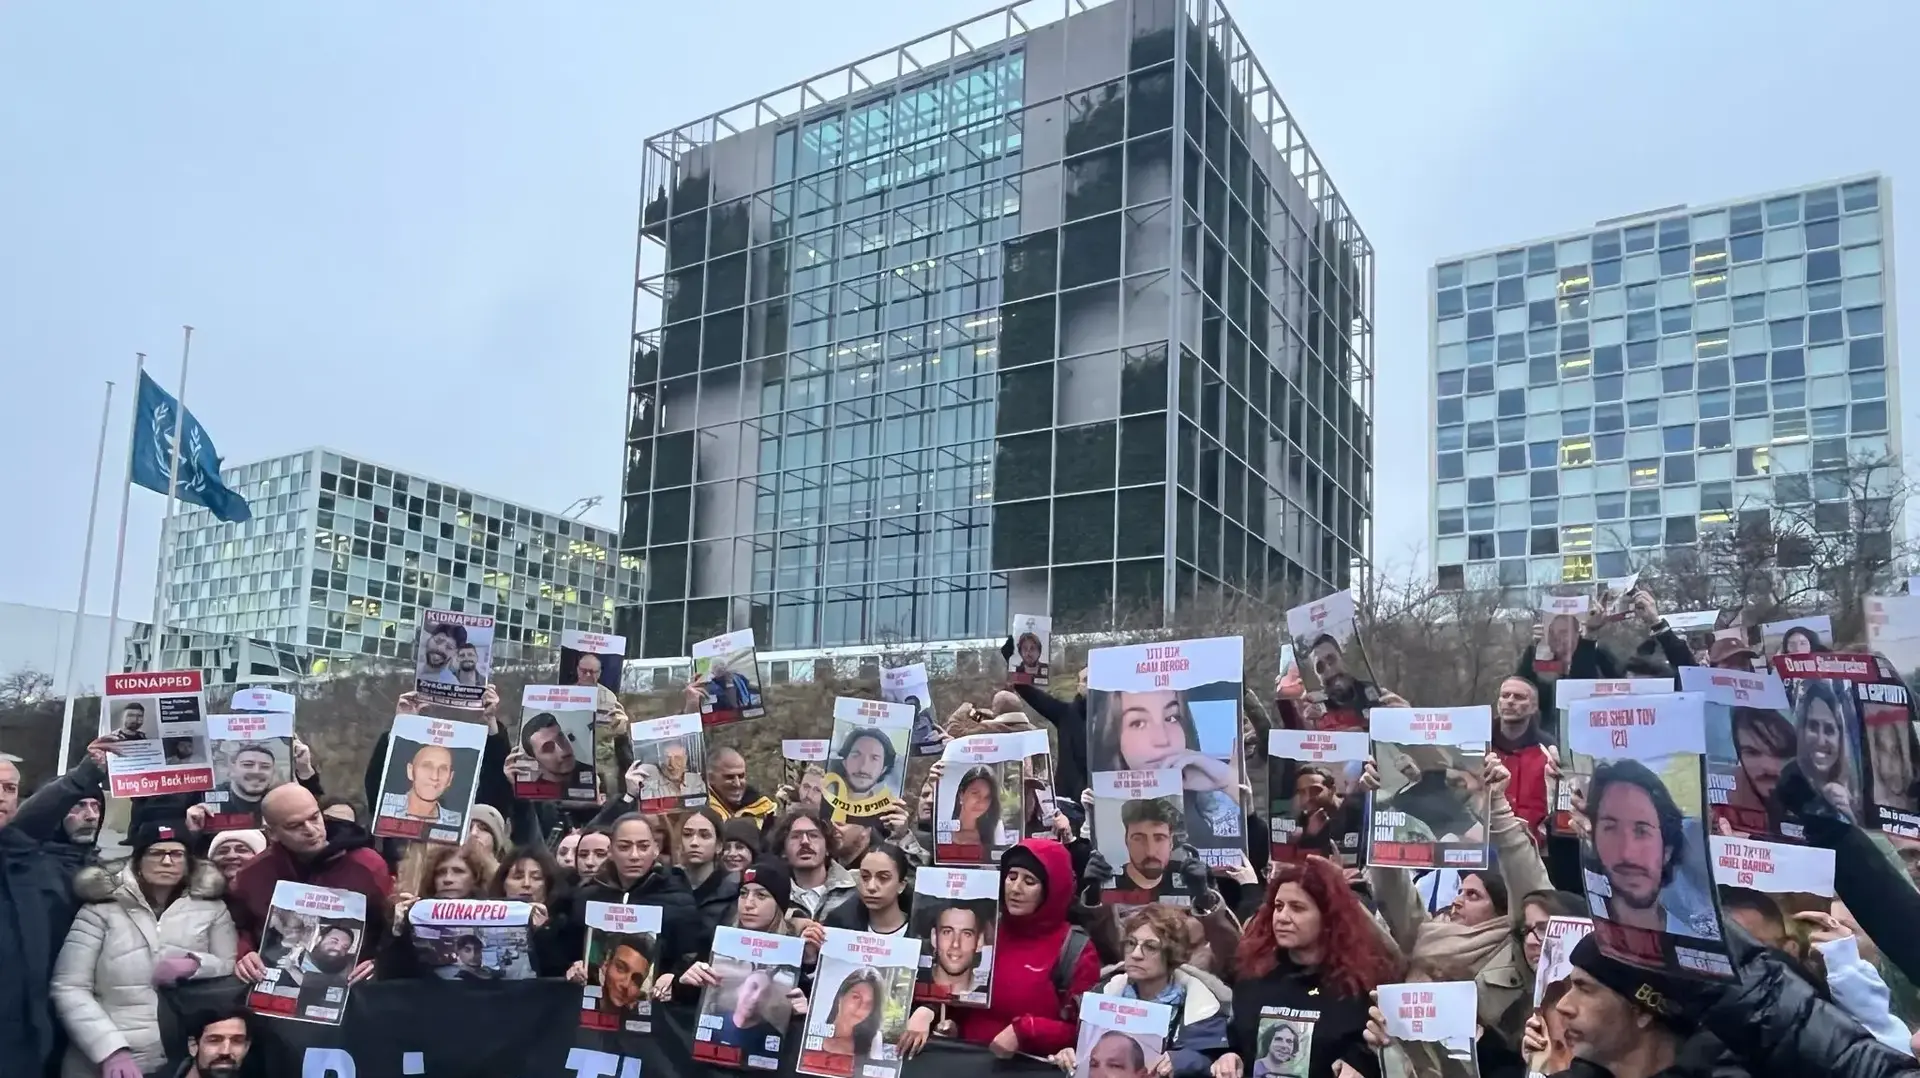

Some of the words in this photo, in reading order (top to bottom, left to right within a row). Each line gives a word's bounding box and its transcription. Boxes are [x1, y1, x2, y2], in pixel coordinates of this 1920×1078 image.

[427, 611, 491, 627] KIDNAPPED
[115, 676, 192, 690] KIDNAPPED
[1611, 729, 1628, 749] (21)
[117, 779, 140, 792] Bring
[141, 777, 159, 791] Guy
[161, 774, 182, 787] Back
[1375, 811, 1406, 827] BRING
[1374, 827, 1394, 841] HIM
[1742, 859, 1775, 874] BARUCH
[431, 902, 508, 920] KIDNAPPED
